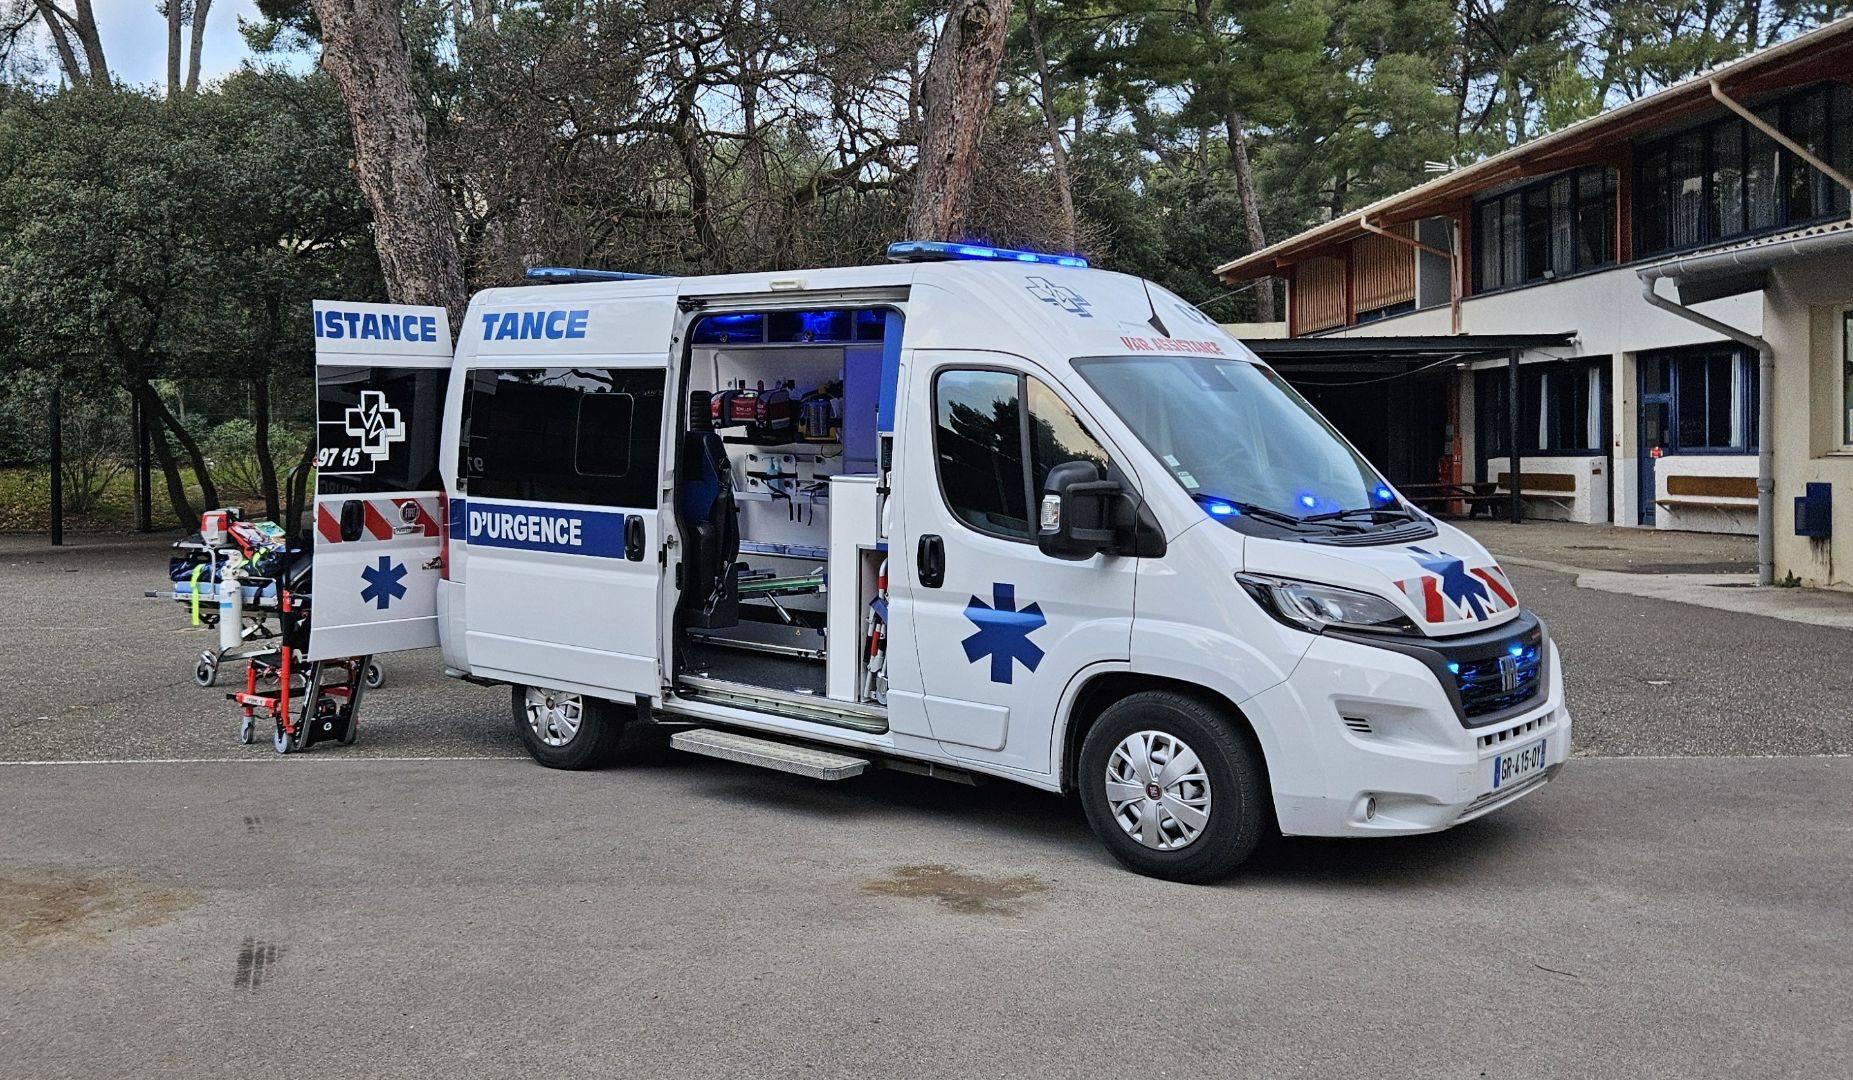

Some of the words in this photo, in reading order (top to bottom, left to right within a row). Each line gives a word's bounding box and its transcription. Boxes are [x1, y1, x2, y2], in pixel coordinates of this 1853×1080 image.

[315, 311, 437, 342] ISTANCE
[482, 310, 589, 340] TANCE
[1120, 336, 1152, 352] VAR
[1152, 338, 1226, 356] ASSISTANCE
[341, 447, 361, 467] 15
[469, 511, 582, 546] D'URGENCE
